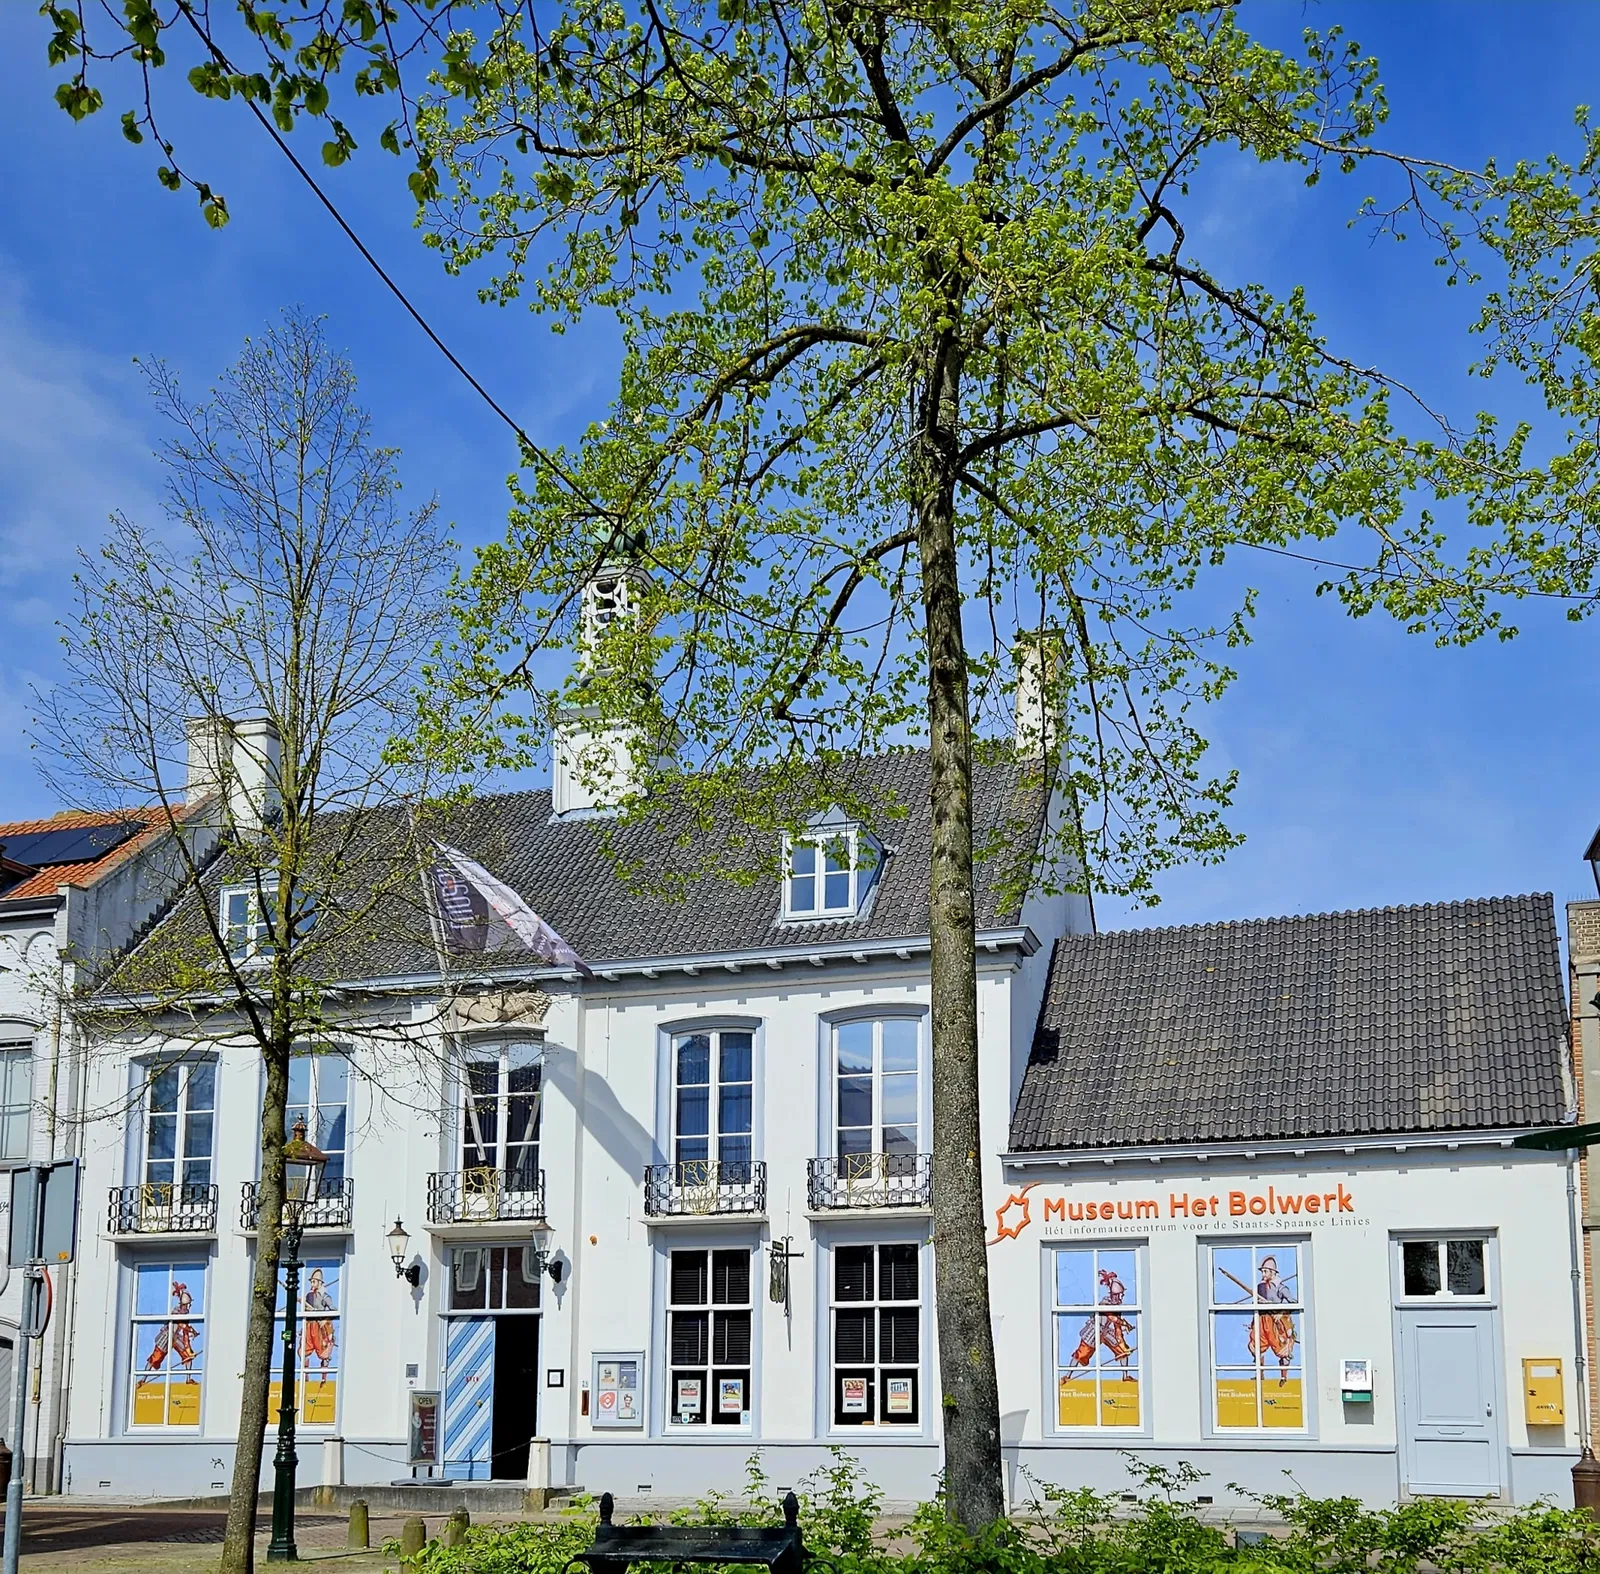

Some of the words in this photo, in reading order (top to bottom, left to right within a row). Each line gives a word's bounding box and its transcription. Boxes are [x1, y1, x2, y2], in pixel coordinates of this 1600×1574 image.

[1043, 1197, 1160, 1222] Museum
[1169, 1193, 1219, 1218] Het
[1229, 1183, 1355, 1217] Bolwerk
[1069, 1223, 1177, 1235] informatiecentrum
[1182, 1222, 1209, 1231] voor
[1213, 1221, 1227, 1230] de
[1232, 1218, 1325, 1230] Staats-Spaanse
[1331, 1217, 1371, 1227] Linies
[418, 1397, 433, 1405] OPEN
